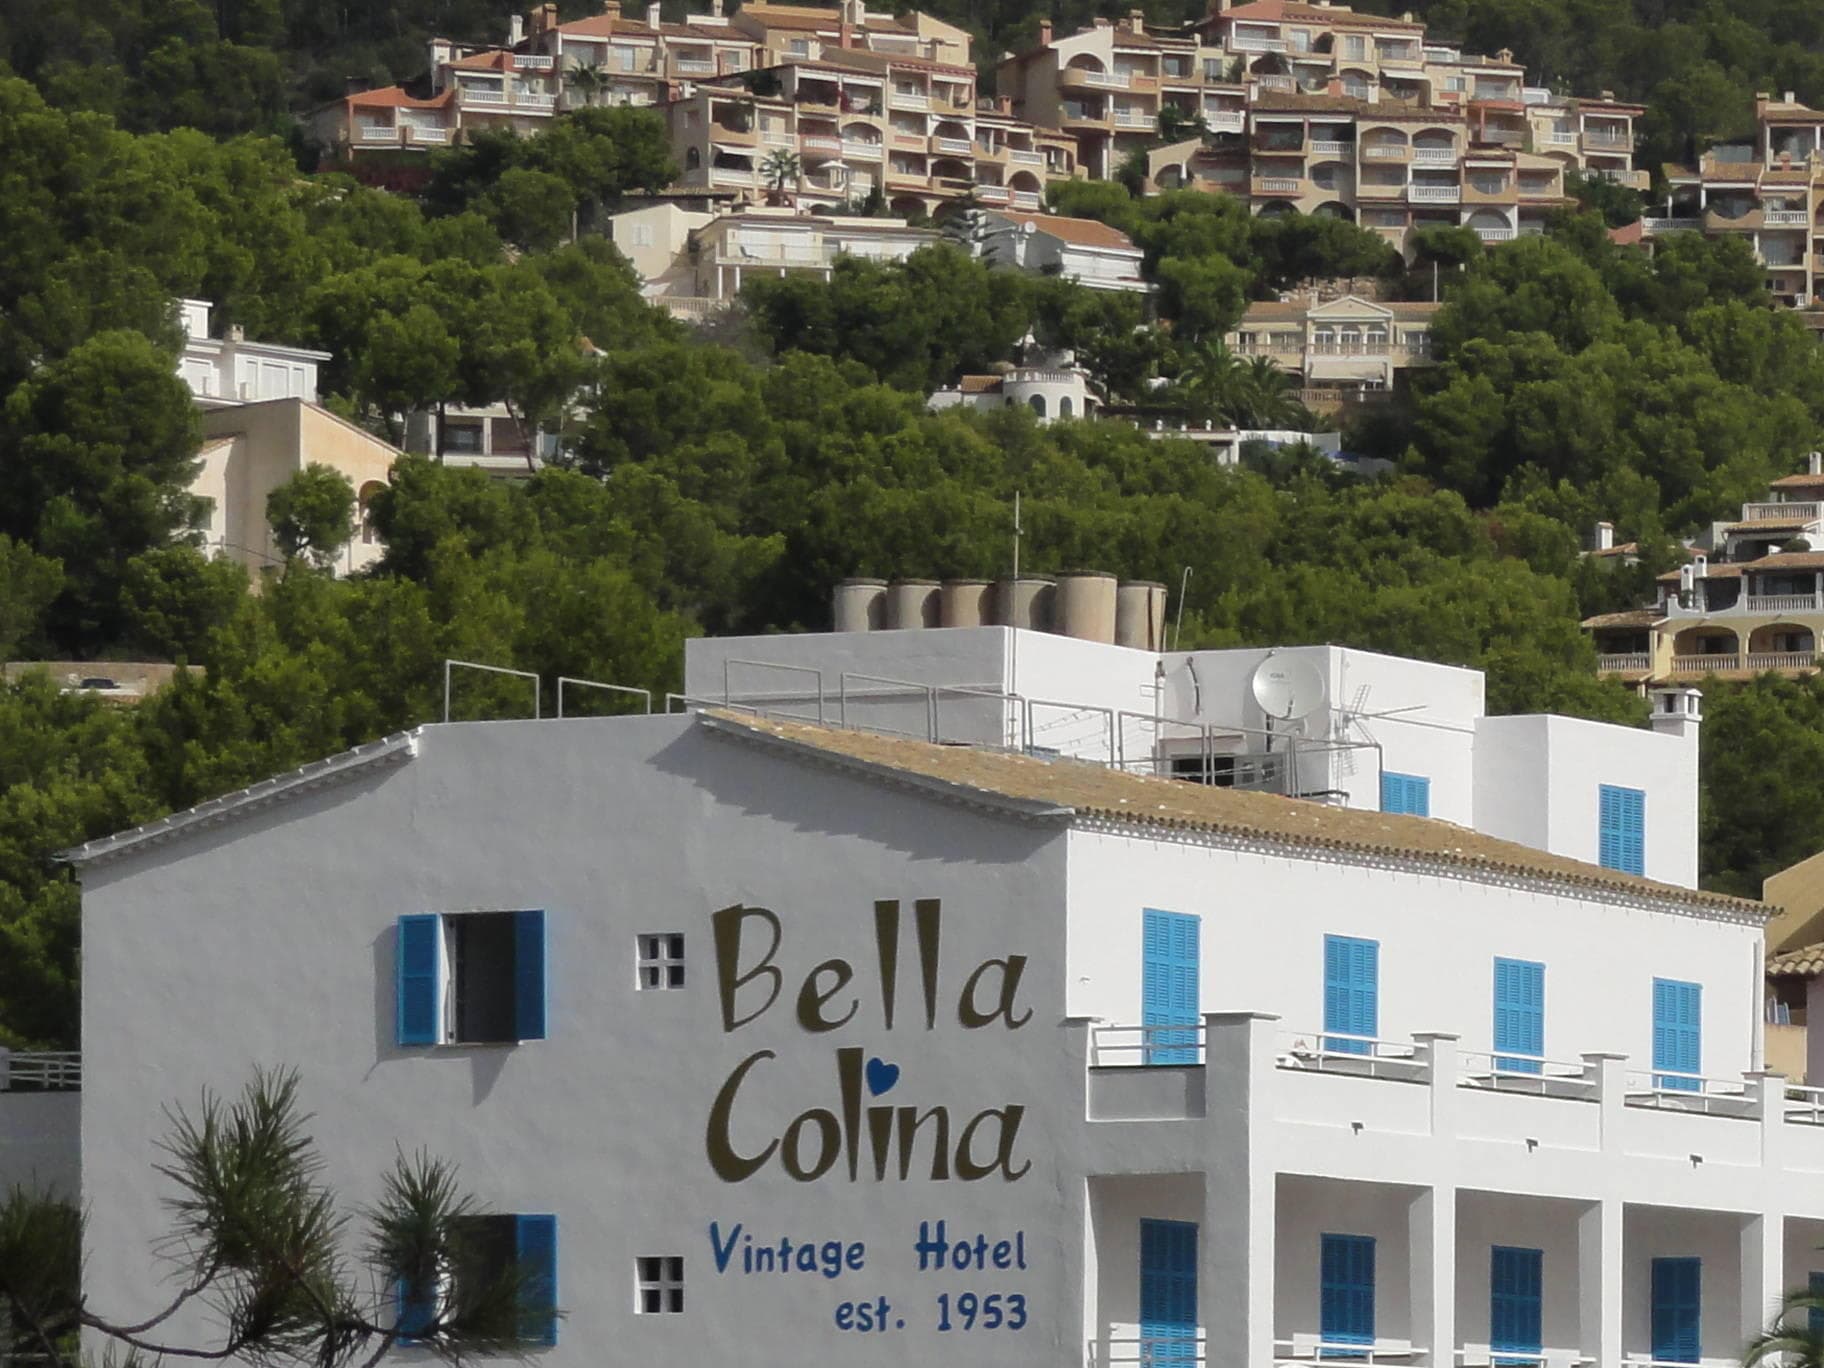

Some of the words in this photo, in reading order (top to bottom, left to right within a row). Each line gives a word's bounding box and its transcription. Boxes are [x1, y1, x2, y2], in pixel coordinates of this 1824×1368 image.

[711, 899, 1033, 1033] Bella
[706, 1048, 1031, 1183] Colina
[709, 1223, 865, 1278] Vintage
[914, 1221, 1027, 1271] Hotel
[835, 1297, 905, 1332] est.
[937, 1293, 1027, 1332] 1953
